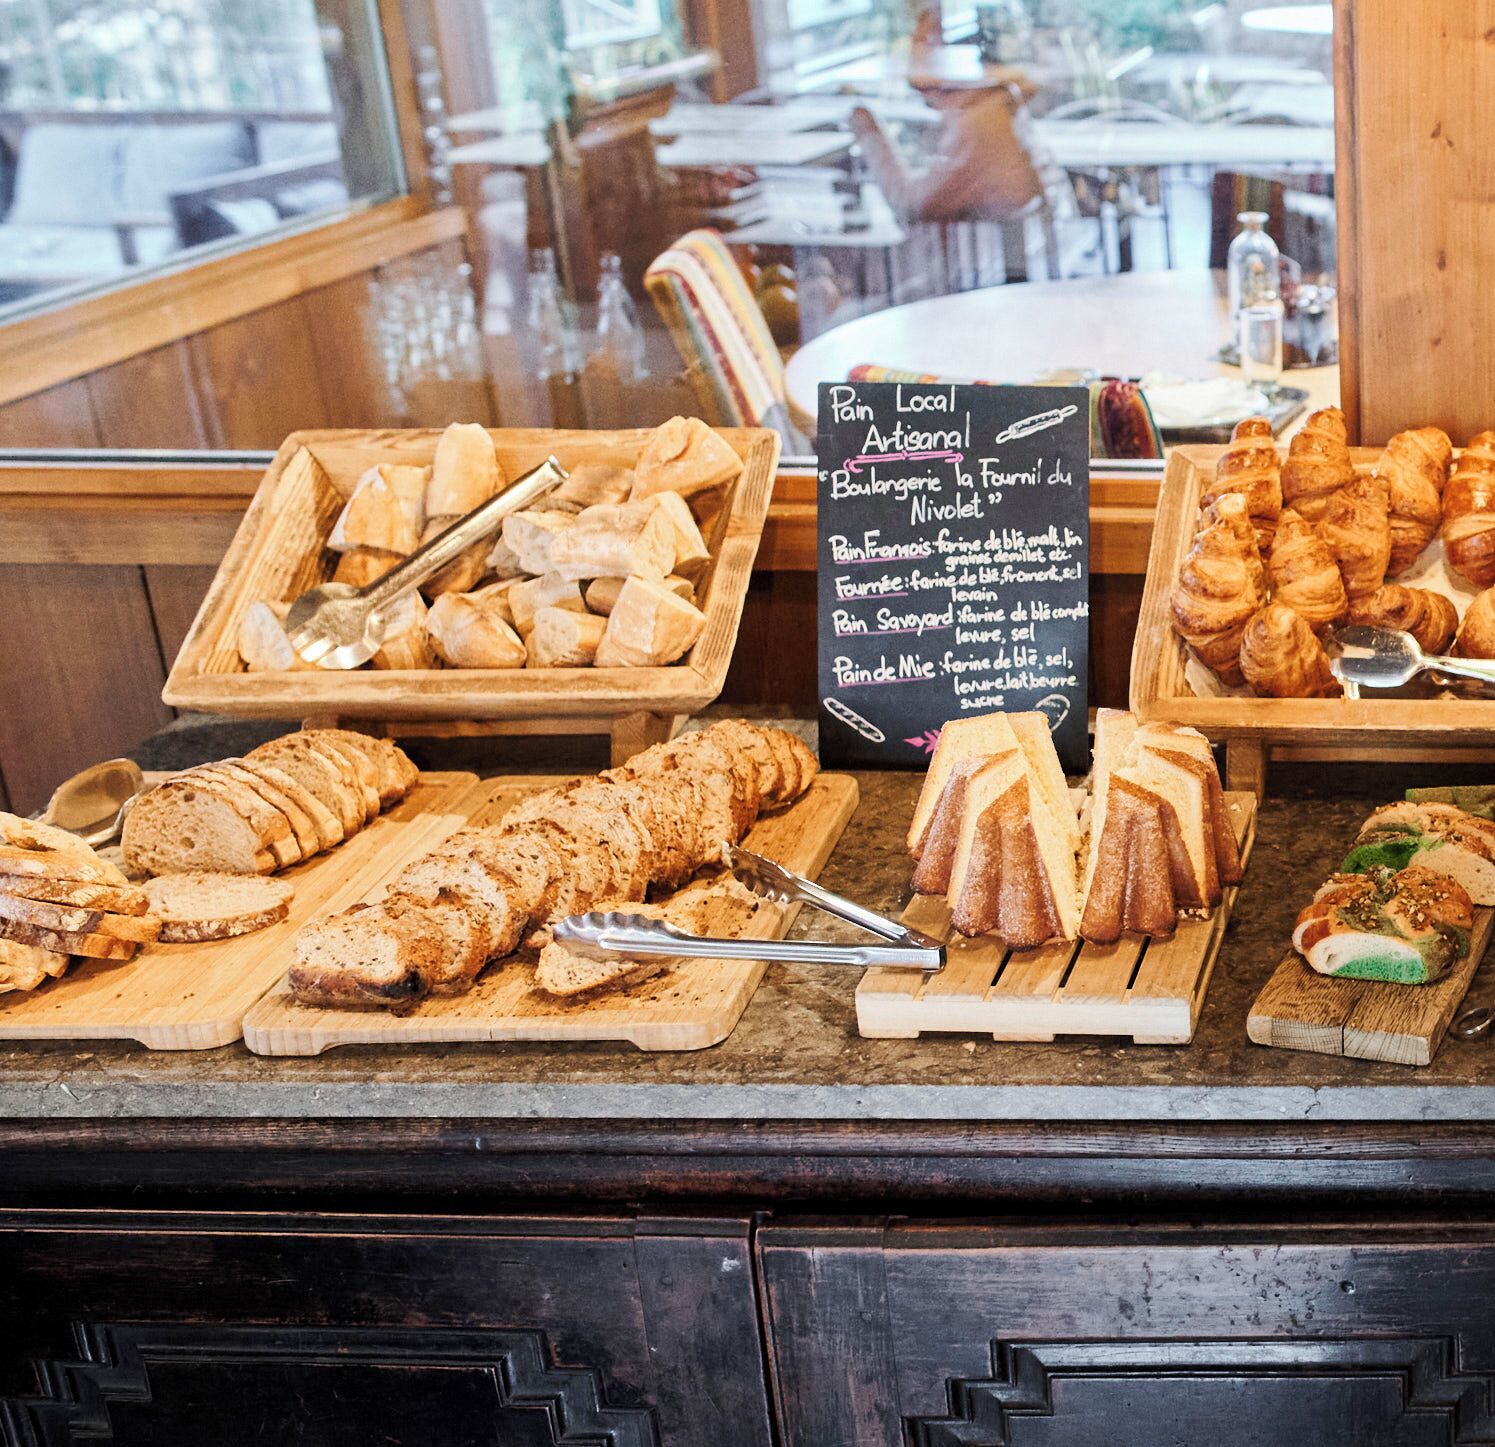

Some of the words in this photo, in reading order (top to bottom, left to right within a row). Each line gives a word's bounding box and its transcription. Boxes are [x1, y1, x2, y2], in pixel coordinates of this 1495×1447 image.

[829, 385, 874, 423] Pain
[896, 383, 956, 413] Local
[861, 410, 971, 454] Artisanal
[954, 462, 975, 489] la
[978, 457, 1042, 489] Fournil
[1047, 457, 1073, 487] du
[828, 534, 865, 561] Pain
[936, 527, 981, 554] farine
[983, 528, 1002, 551] de
[944, 550, 993, 573] graines
[1048, 546, 1073, 562] etc.
[958, 566, 978, 587] de
[1062, 560, 1082, 580] sel
[951, 587, 999, 602] levain
[832, 608, 869, 634] Pain
[876, 601, 954, 637] Savoyard
[1009, 600, 1028, 621] de
[1030, 600, 1051, 622] blé
[955, 626, 1007, 645] levure,
[1010, 621, 1036, 642] sel
[832, 655, 872, 686] Pain
[872, 654, 898, 682] de
[898, 653, 937, 680] Mie
[992, 646, 1013, 670] de
[1045, 646, 1074, 670] sel,
[960, 694, 1006, 710] sucre
